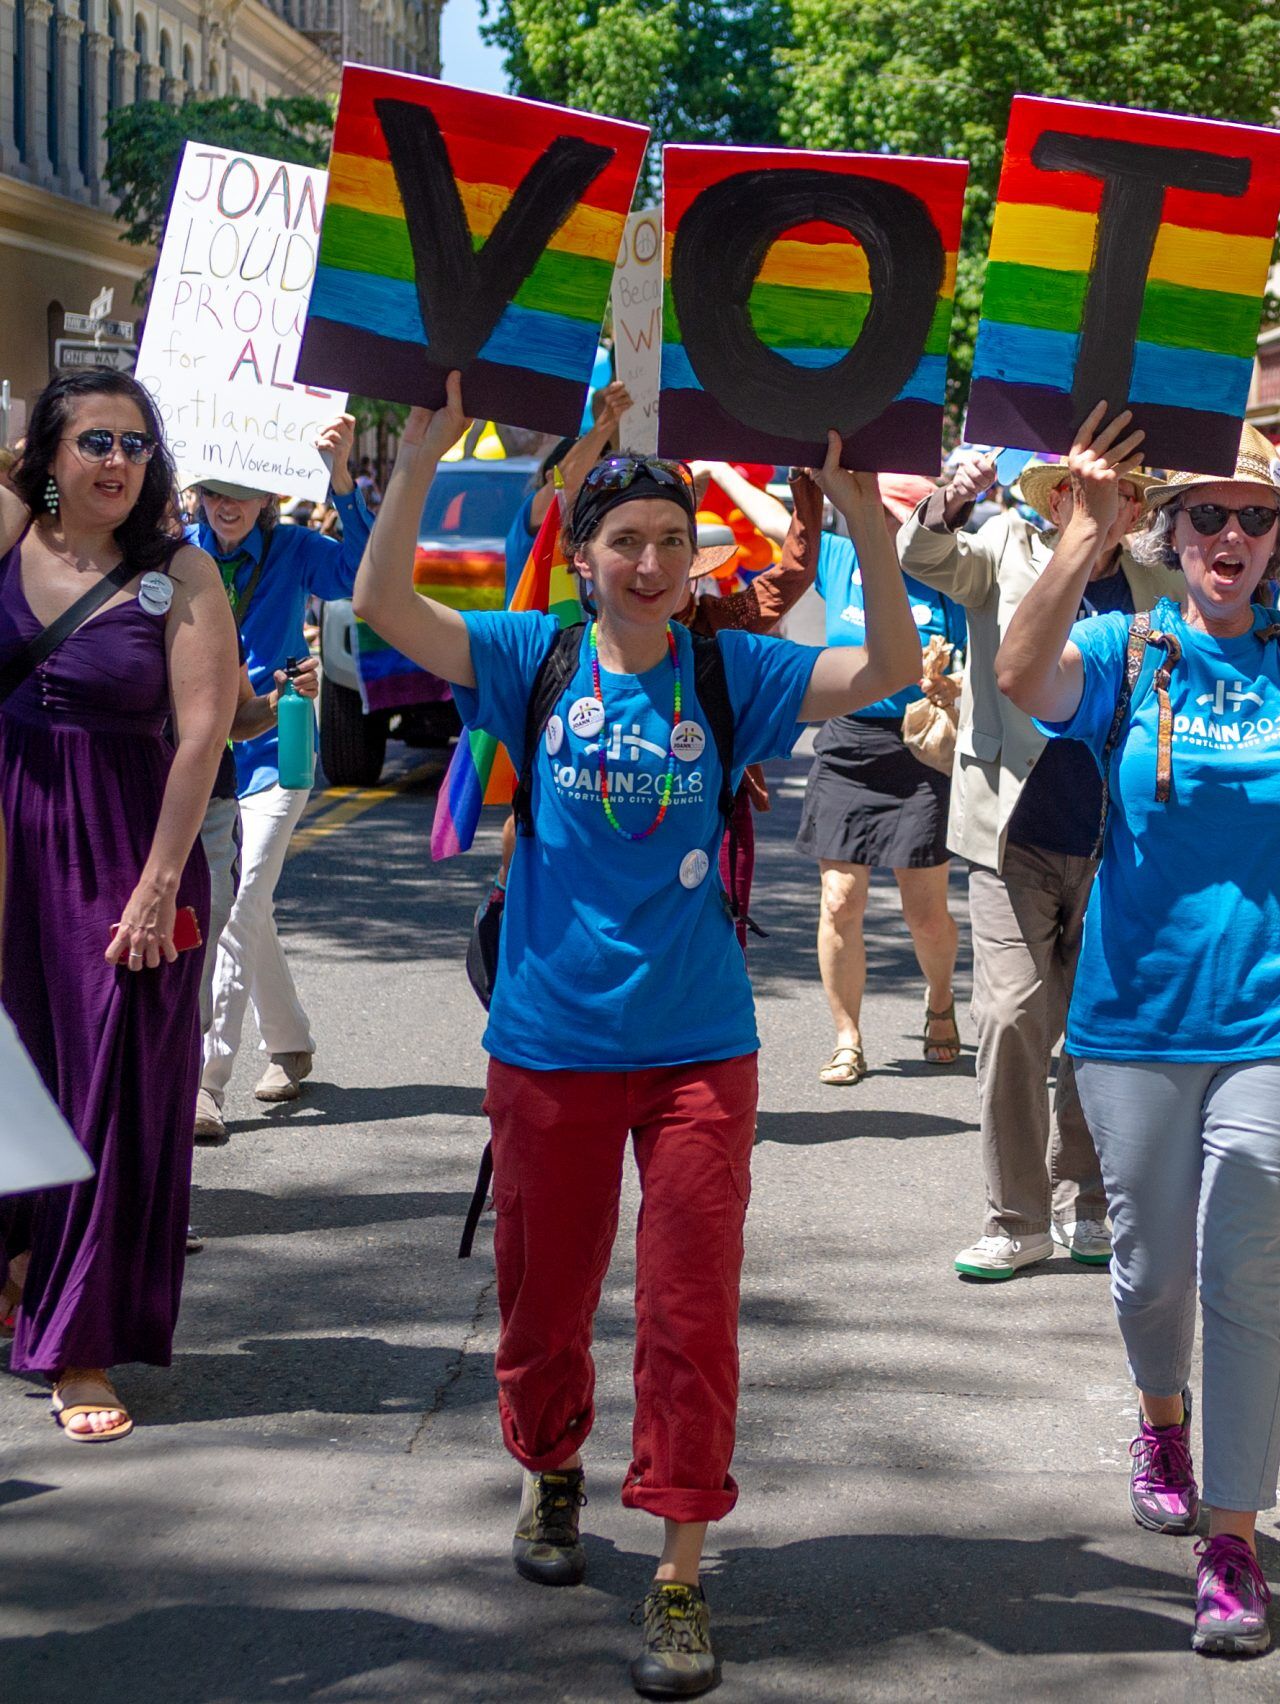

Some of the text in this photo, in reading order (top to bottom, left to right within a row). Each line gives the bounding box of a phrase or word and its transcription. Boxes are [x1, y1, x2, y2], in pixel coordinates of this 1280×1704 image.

[180, 217, 316, 292] LOUD
[161, 329, 208, 368] for
[202, 443, 223, 465] in
[227, 440, 324, 481] November
[1182, 734, 1235, 751] PORTLAND
[567, 791, 625, 804] PORTLND
[628, 796, 654, 805] CITY
